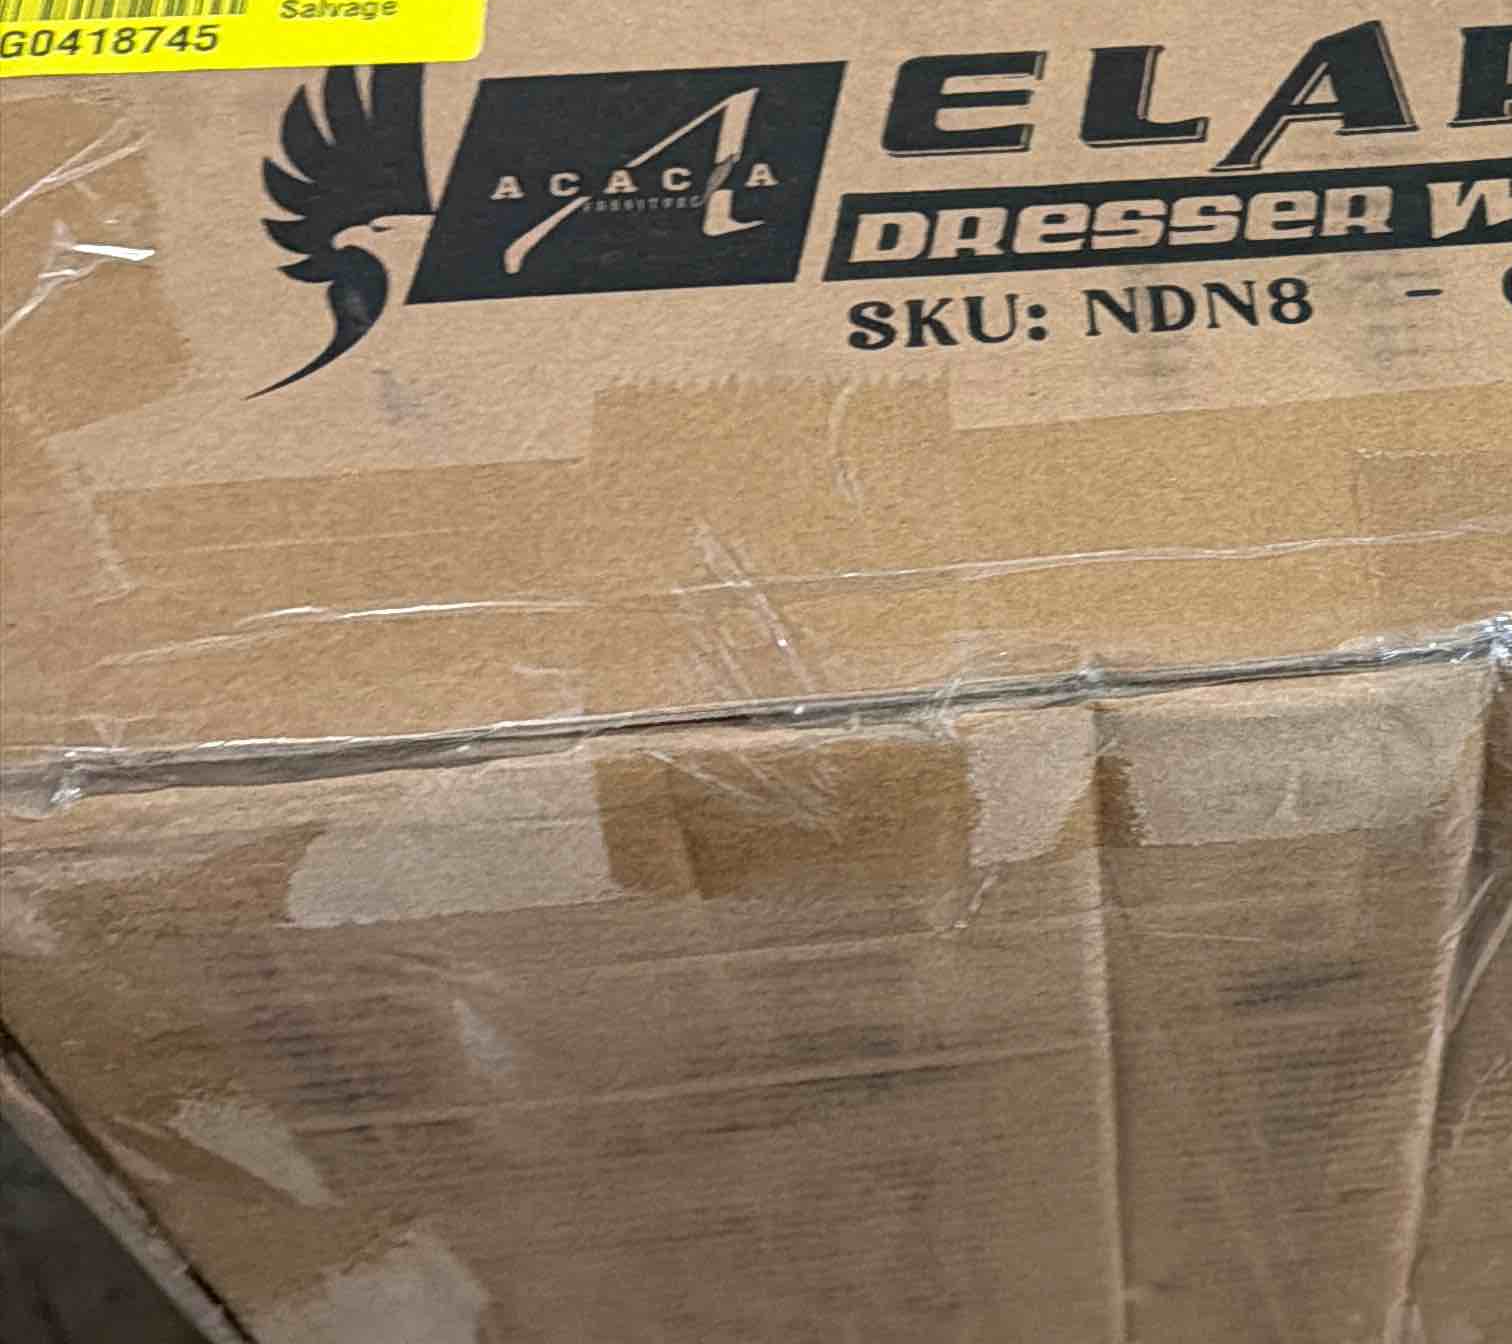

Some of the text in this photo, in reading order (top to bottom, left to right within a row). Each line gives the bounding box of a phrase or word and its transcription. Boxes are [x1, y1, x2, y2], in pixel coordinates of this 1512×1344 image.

[0, 23, 220, 59] G0418745
[846, 296, 1050, 352] SKU:
[1084, 276, 1314, 339] NDN8
